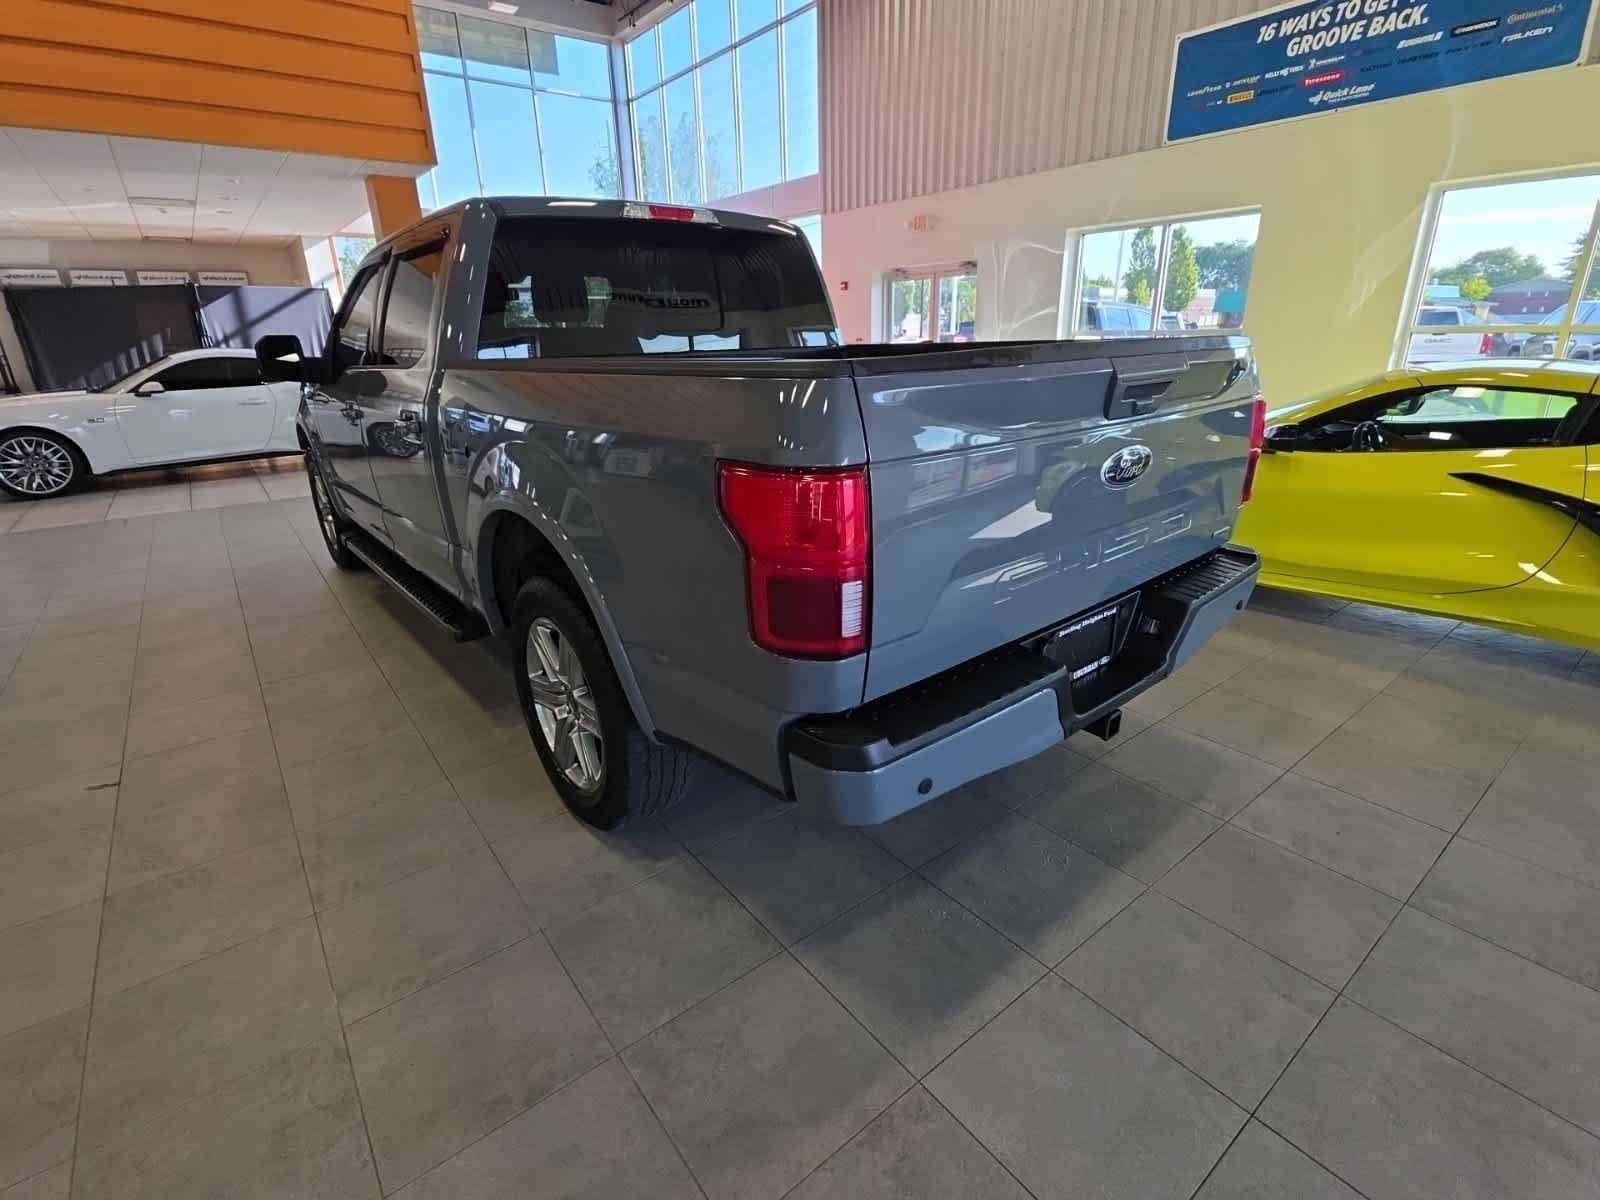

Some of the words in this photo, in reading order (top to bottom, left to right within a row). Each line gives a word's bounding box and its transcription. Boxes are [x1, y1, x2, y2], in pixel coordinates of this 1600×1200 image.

[1256, 22, 1278, 44] 16
[1279, 5, 1333, 38] WAYS
[1335, 0, 1362, 23] TO
[1286, 20, 1368, 57] GROOVE
[1366, 3, 1431, 38] BACK.
